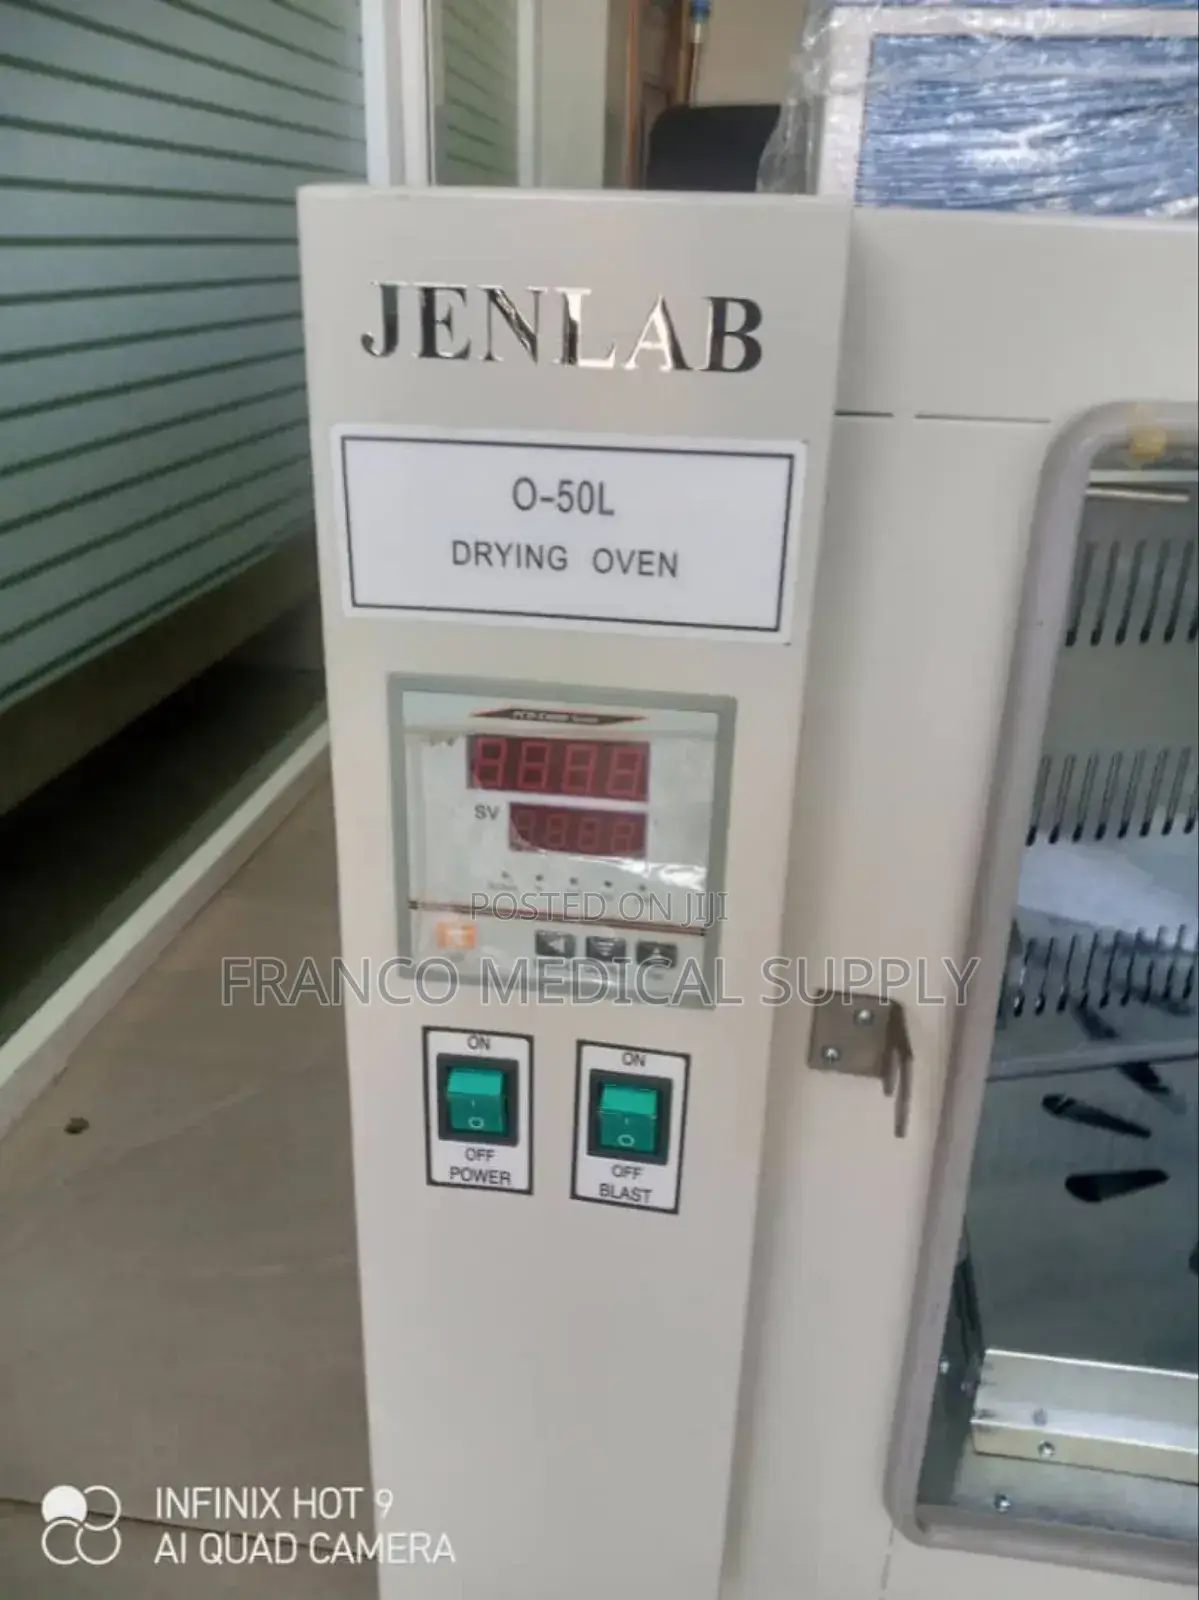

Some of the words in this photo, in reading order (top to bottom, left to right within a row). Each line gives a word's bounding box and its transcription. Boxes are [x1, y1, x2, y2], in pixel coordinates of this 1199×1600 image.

[361, 281, 763, 373] JENLAB
[512, 476, 616, 516] O-50L
[451, 539, 569, 571] DRYING
[592, 548, 679, 578] OVEN
[474, 804, 499, 820] SV
[466, 1034, 491, 1050] ON
[621, 1052, 646, 1067] ON
[464, 1147, 495, 1162] OFF
[449, 1166, 512, 1186] POWER
[611, 1164, 644, 1179] OFF
[599, 1183, 652, 1204] BLAST
